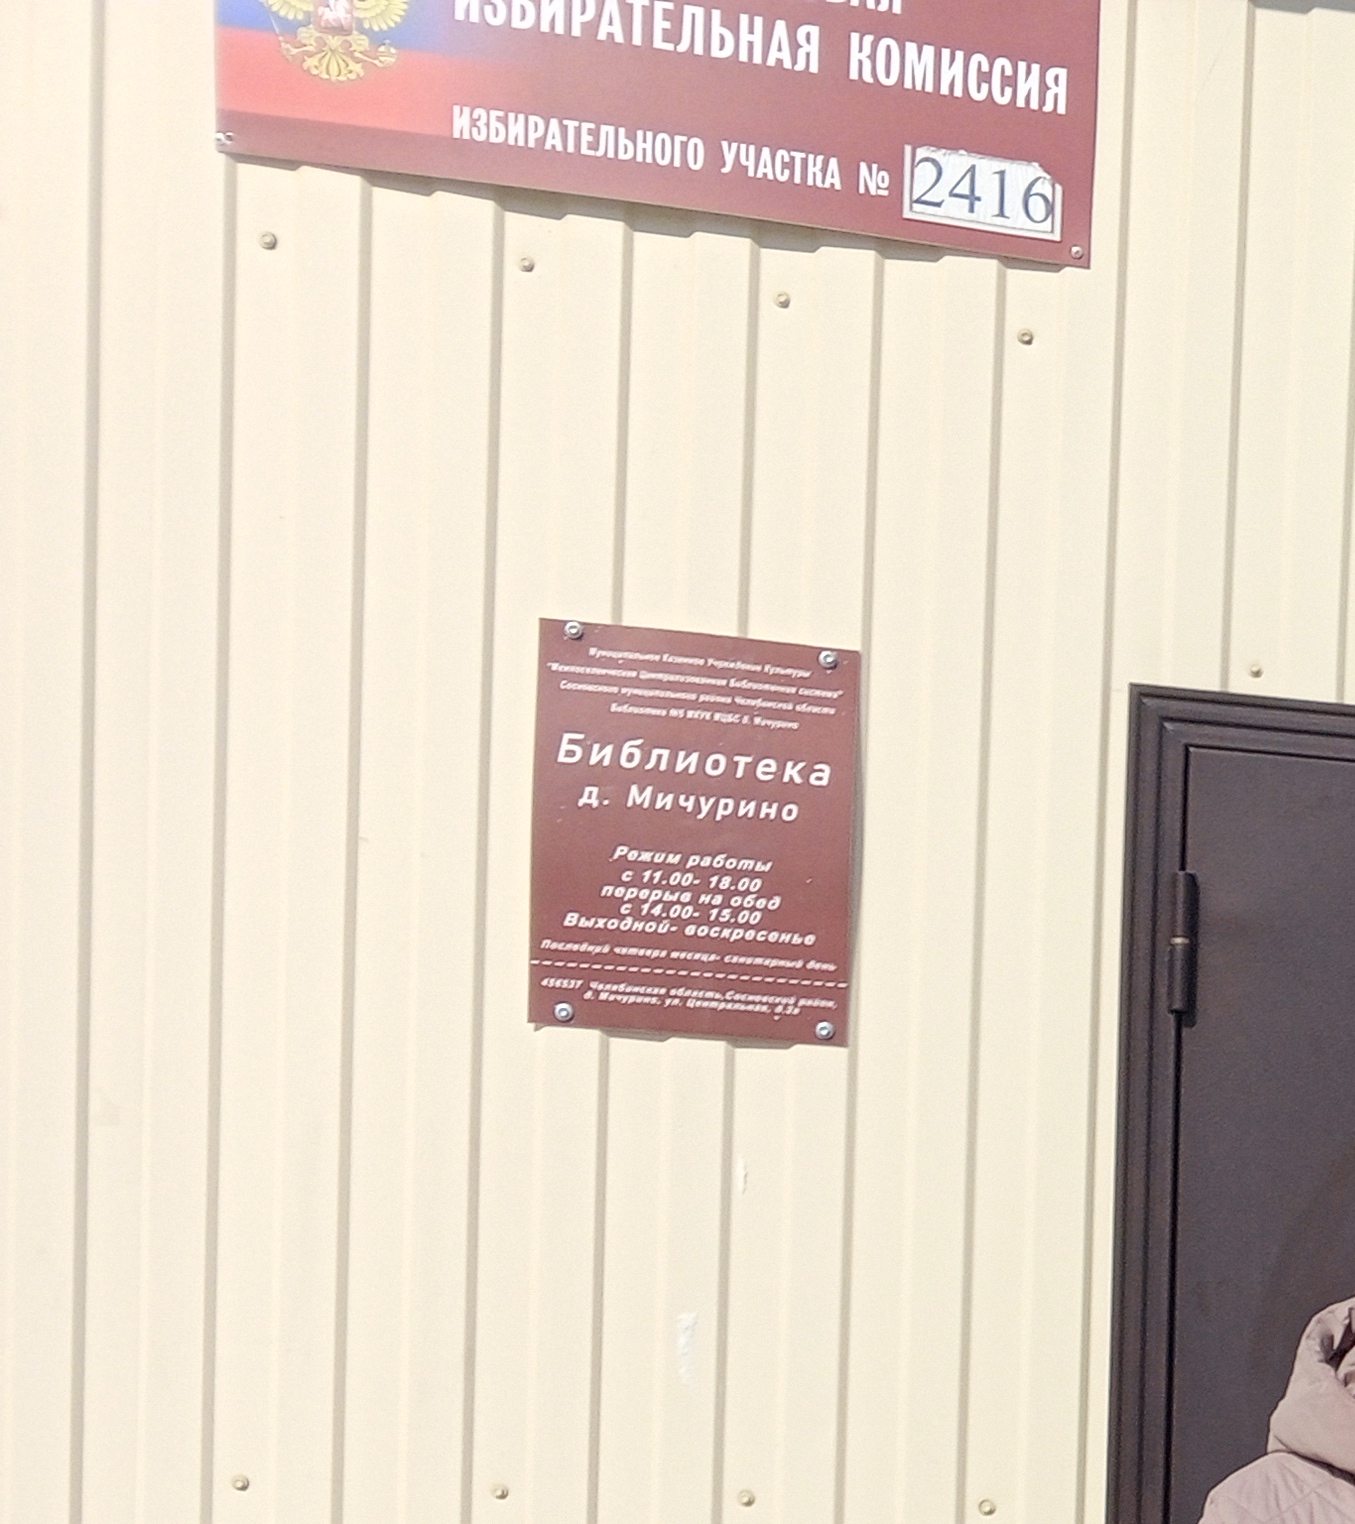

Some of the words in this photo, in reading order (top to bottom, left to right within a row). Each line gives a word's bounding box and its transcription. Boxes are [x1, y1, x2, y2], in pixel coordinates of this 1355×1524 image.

[849, 31, 1068, 115] КОМИССИЯ
[452, 105, 705, 171] ИЗБИРАТЕЛЬНОГО
[720, 142, 841, 191] УЧАСТКА
[858, 164, 890, 196] №
[912, 156, 1055, 225] 2416
[557, 732, 830, 786] Библиотека
[577, 786, 609, 808] д.
[626, 783, 798, 821] Мичурино
[612, 845, 681, 864] Режим
[685, 853, 772, 871] работы
[621, 870, 633, 881] с
[642, 869, 700, 886] 11.00-
[709, 875, 762, 892] 18.00
[600, 885, 692, 902] перерыв
[698, 893, 723, 905] на
[729, 893, 781, 910] обед
[619, 903, 632, 914] с
[640, 901, 699, 919] 14.00-
[709, 907, 762, 924] 15.00
[684, 924, 816, 945] воскресенье
